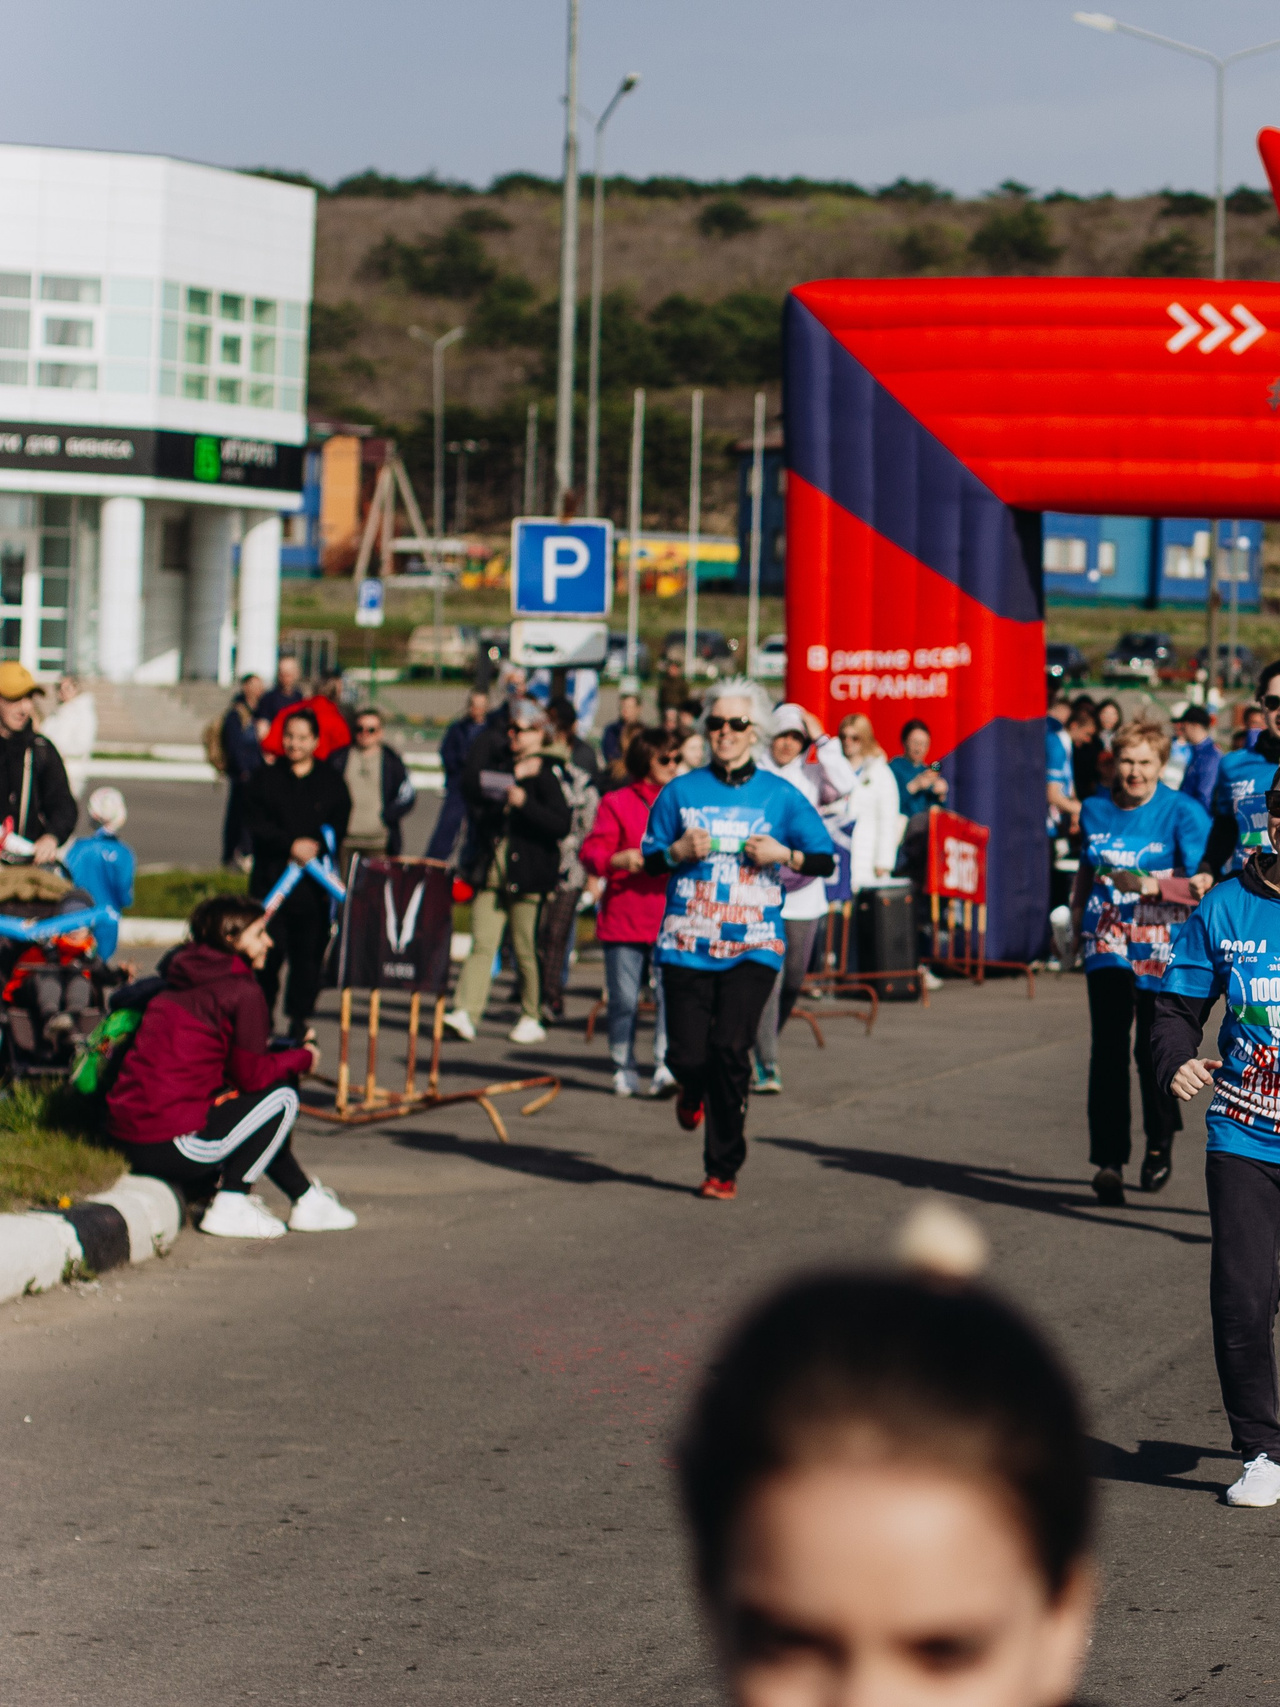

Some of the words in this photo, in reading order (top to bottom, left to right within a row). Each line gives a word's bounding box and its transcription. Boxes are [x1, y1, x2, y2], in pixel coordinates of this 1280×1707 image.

[543, 536, 590, 604] P
[807, 645, 828, 671] В
[830, 649, 910, 674] ритме
[914, 643, 971, 669] всей
[830, 673, 948, 700] СТРАНЫ!
